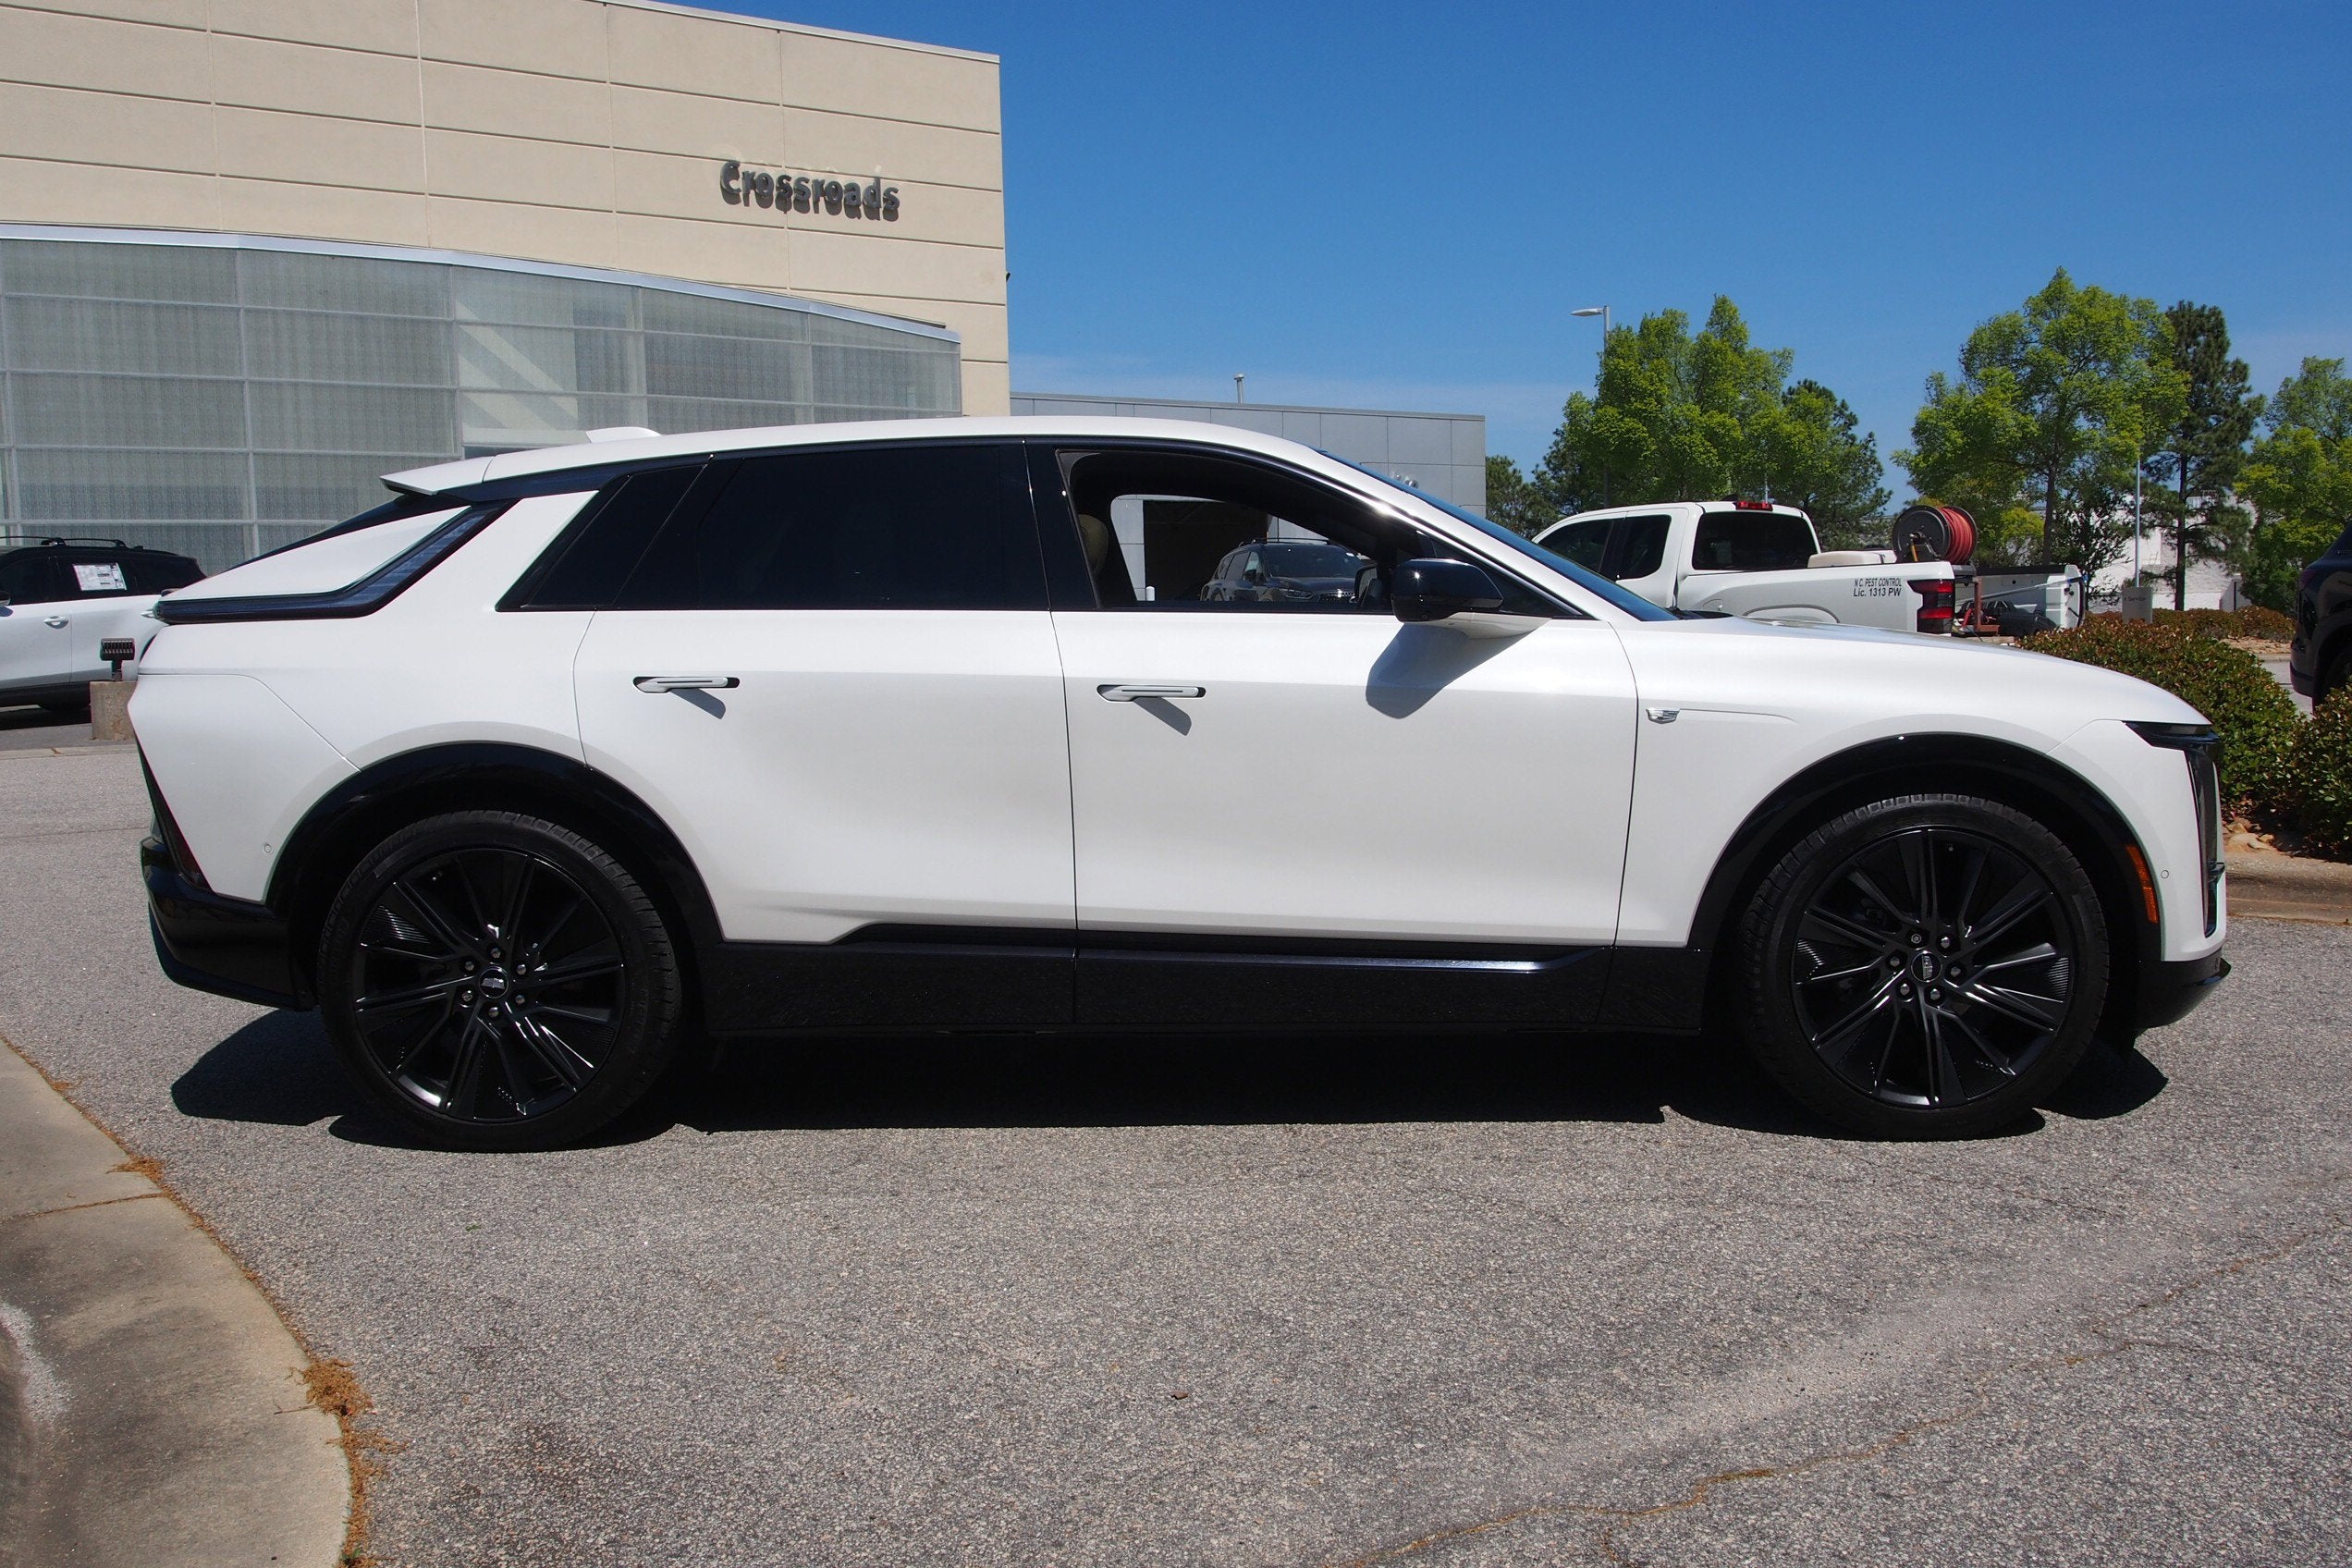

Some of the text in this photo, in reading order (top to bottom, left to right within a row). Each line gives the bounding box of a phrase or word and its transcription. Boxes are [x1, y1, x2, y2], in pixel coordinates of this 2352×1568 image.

[720, 160, 900, 213] Crossroads
[1865, 578, 1878, 587] PEST
[1878, 577, 1902, 587] CONTROL
[1853, 587, 1902, 597] Lic. 1313 PW
